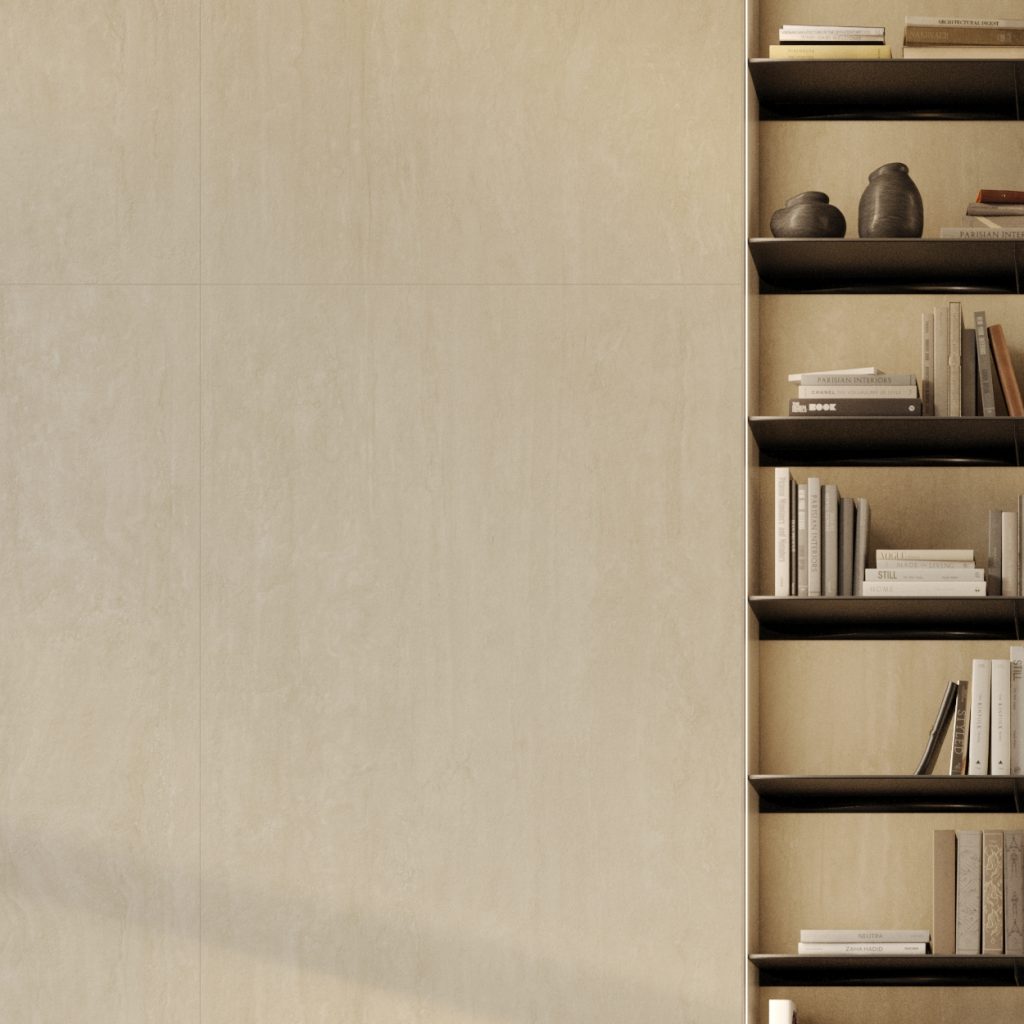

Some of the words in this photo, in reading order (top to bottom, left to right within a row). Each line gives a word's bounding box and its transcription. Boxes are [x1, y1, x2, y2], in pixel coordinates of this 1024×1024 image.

[960, 231, 1000, 239] PARISIAN
[808, 403, 837, 411] BOOK
[810, 495, 818, 530] PARISIAN
[810, 532, 818, 572] INTERIORS
[878, 570, 897, 579] STILL
[1013, 659, 1022, 681] STILL
[954, 708, 966, 754] STYLED
